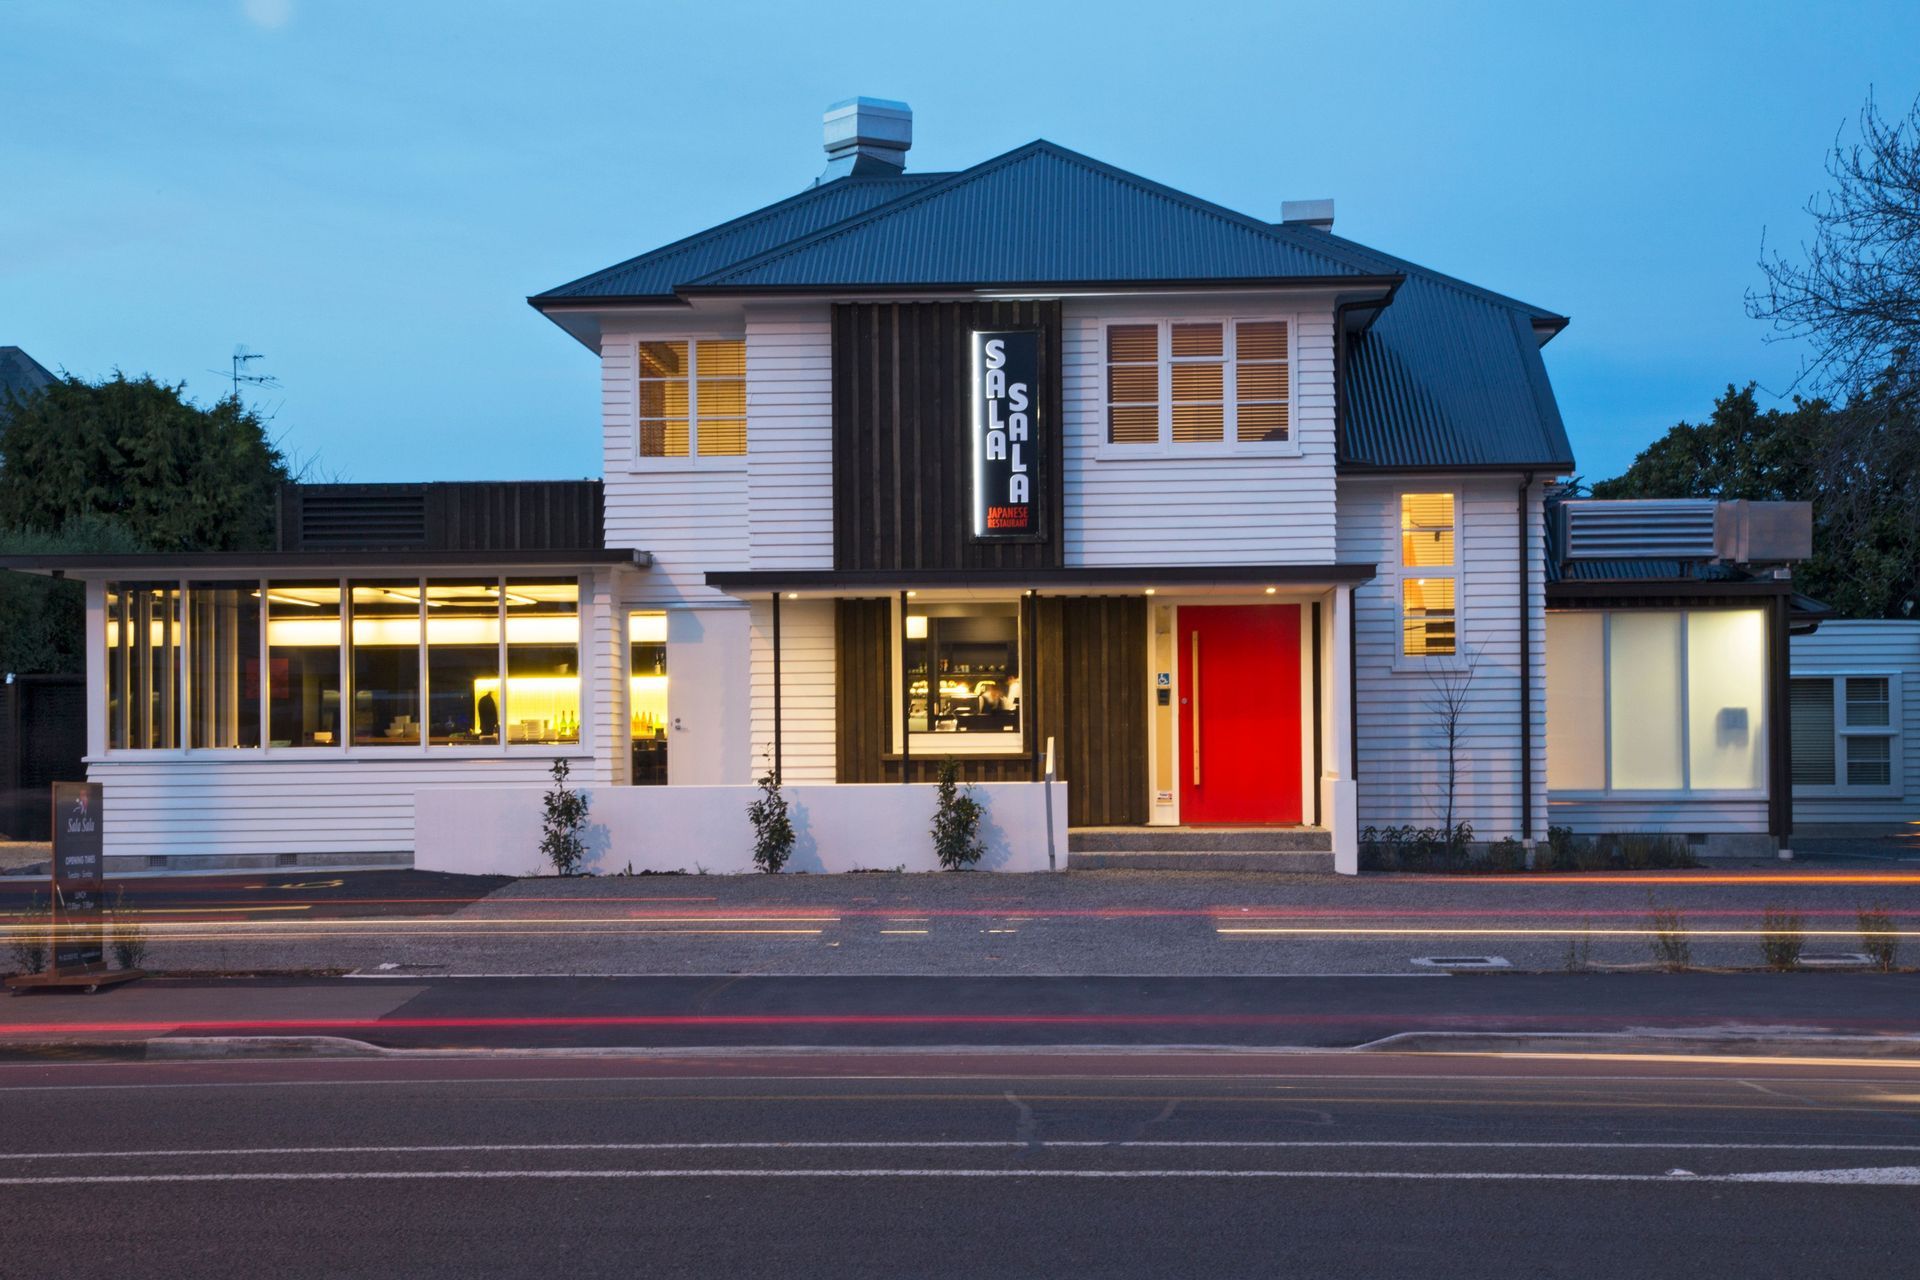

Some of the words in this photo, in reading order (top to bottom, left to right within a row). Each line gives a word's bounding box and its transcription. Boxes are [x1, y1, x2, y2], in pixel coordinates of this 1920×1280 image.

[985, 339, 1006, 460] SALA
[1008, 383, 1029, 503] SALA
[987, 506, 1029, 518] JAPANESE
[987, 518, 1028, 528] RESTAURANT
